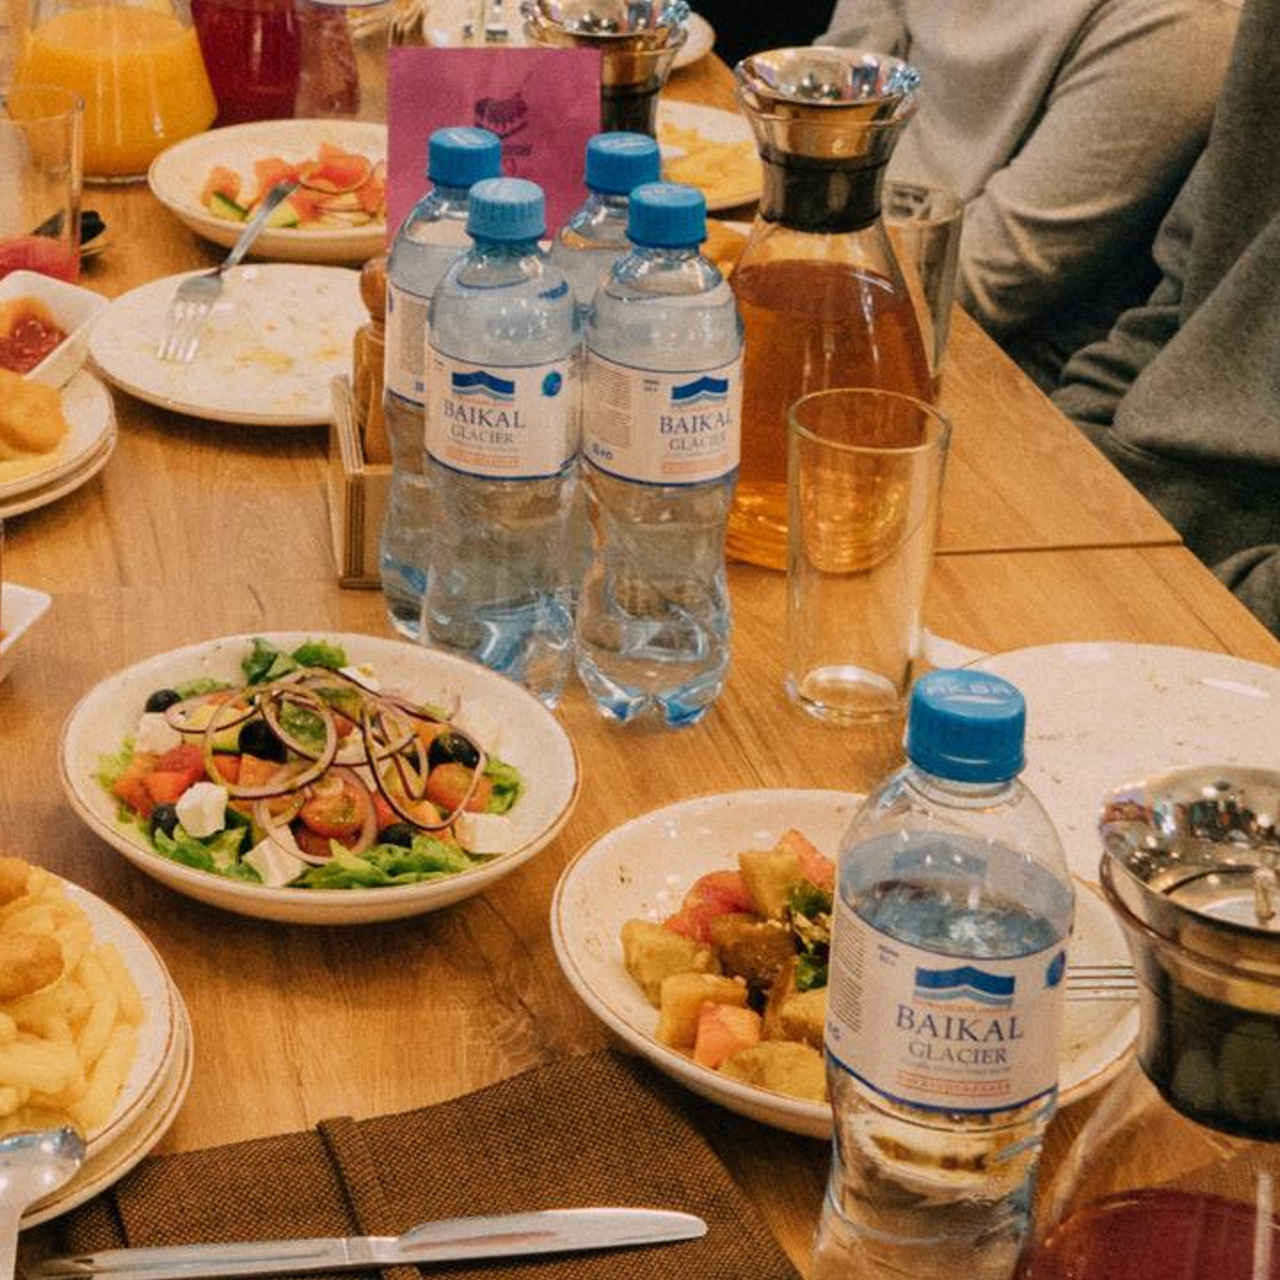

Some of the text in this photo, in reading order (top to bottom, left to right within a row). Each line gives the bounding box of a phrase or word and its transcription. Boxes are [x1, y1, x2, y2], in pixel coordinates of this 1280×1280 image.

[443, 399, 528, 429] BAIKAL
[660, 407, 733, 435] BAIKAL
[450, 425, 514, 445] GLACIER
[896, 1004, 1023, 1043] BAIKAL
[908, 1041, 1008, 1065] GLACIER
